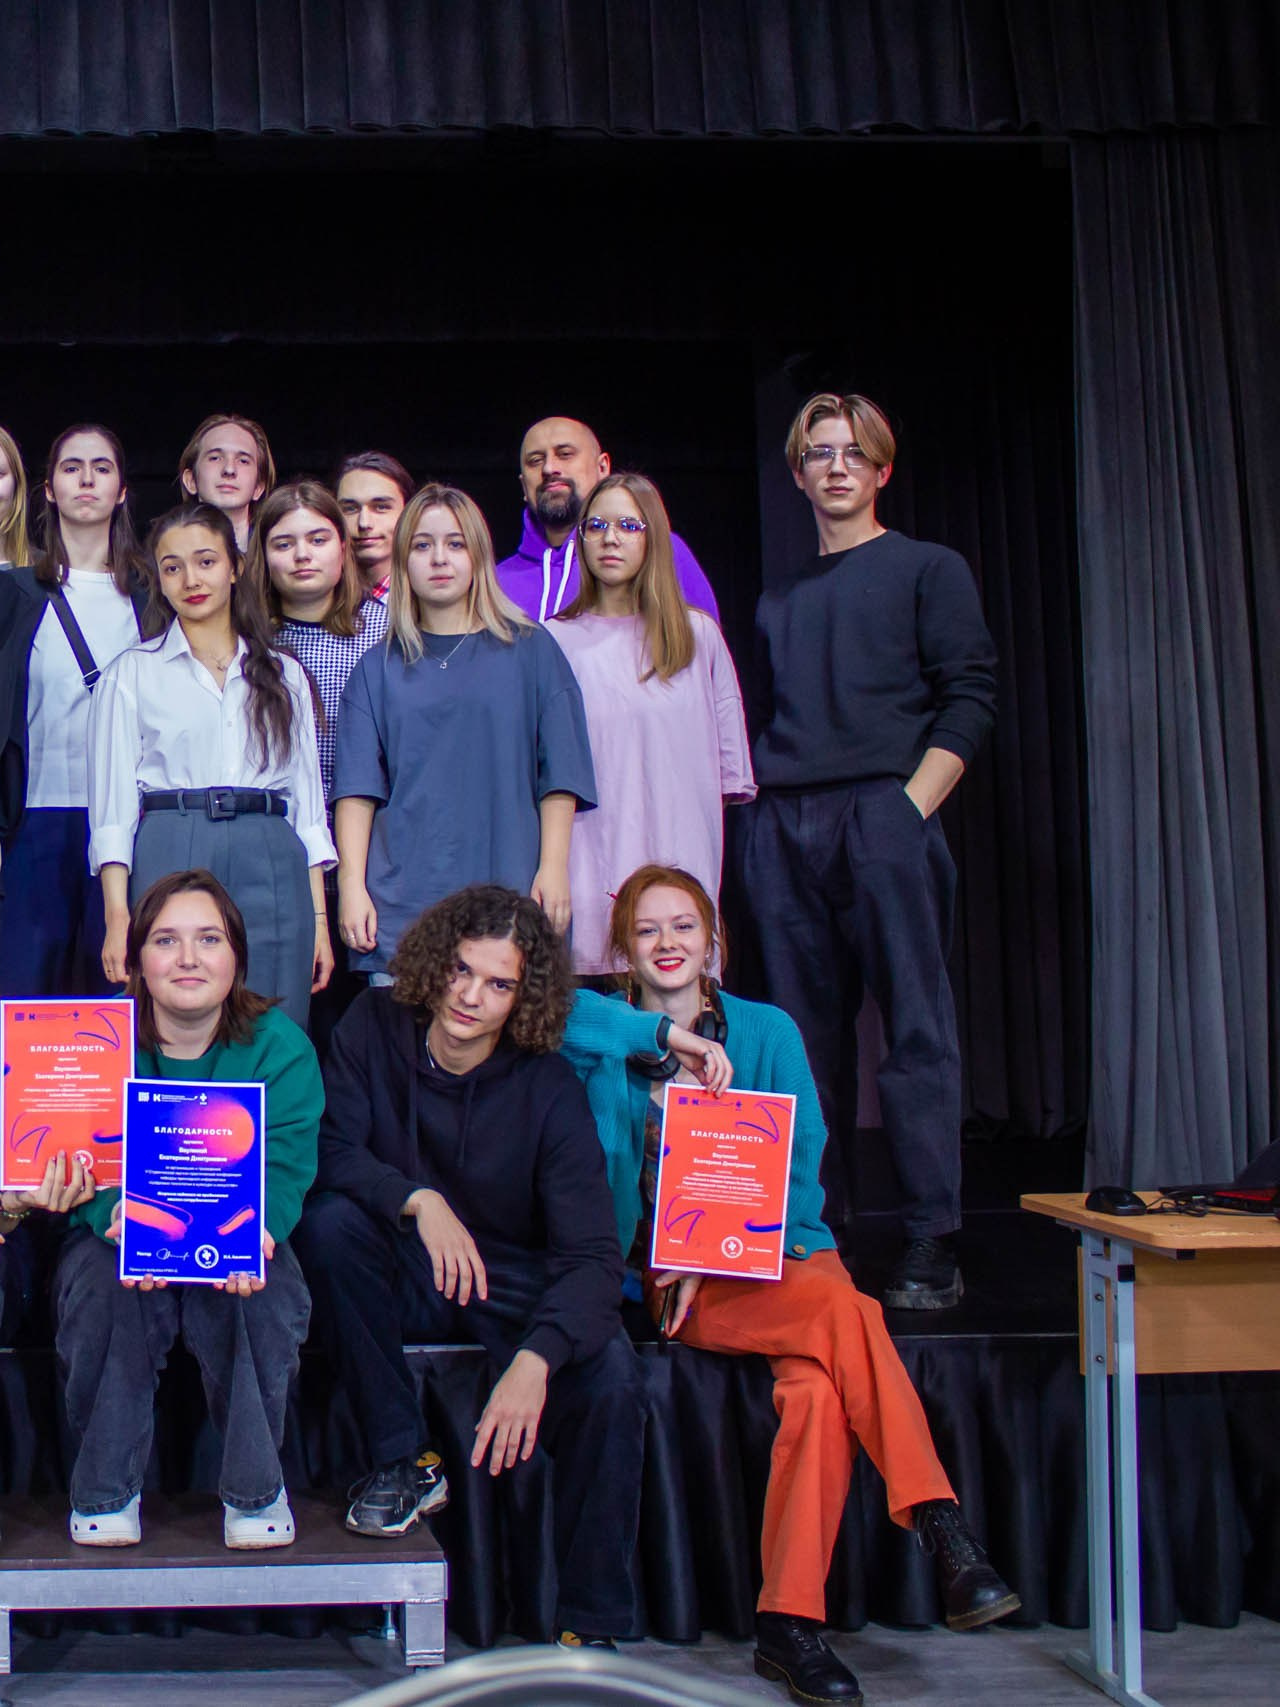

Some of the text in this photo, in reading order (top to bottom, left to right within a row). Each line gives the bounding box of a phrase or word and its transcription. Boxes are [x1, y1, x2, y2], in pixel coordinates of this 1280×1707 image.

[30, 1045, 105, 1053] БЛАГОДАРНОСТЬ
[154, 1126, 233, 1136] БЛАГОДАРНОСТЬ
[690, 1130, 763, 1143] БЛАГОДАРНОСТЬ
